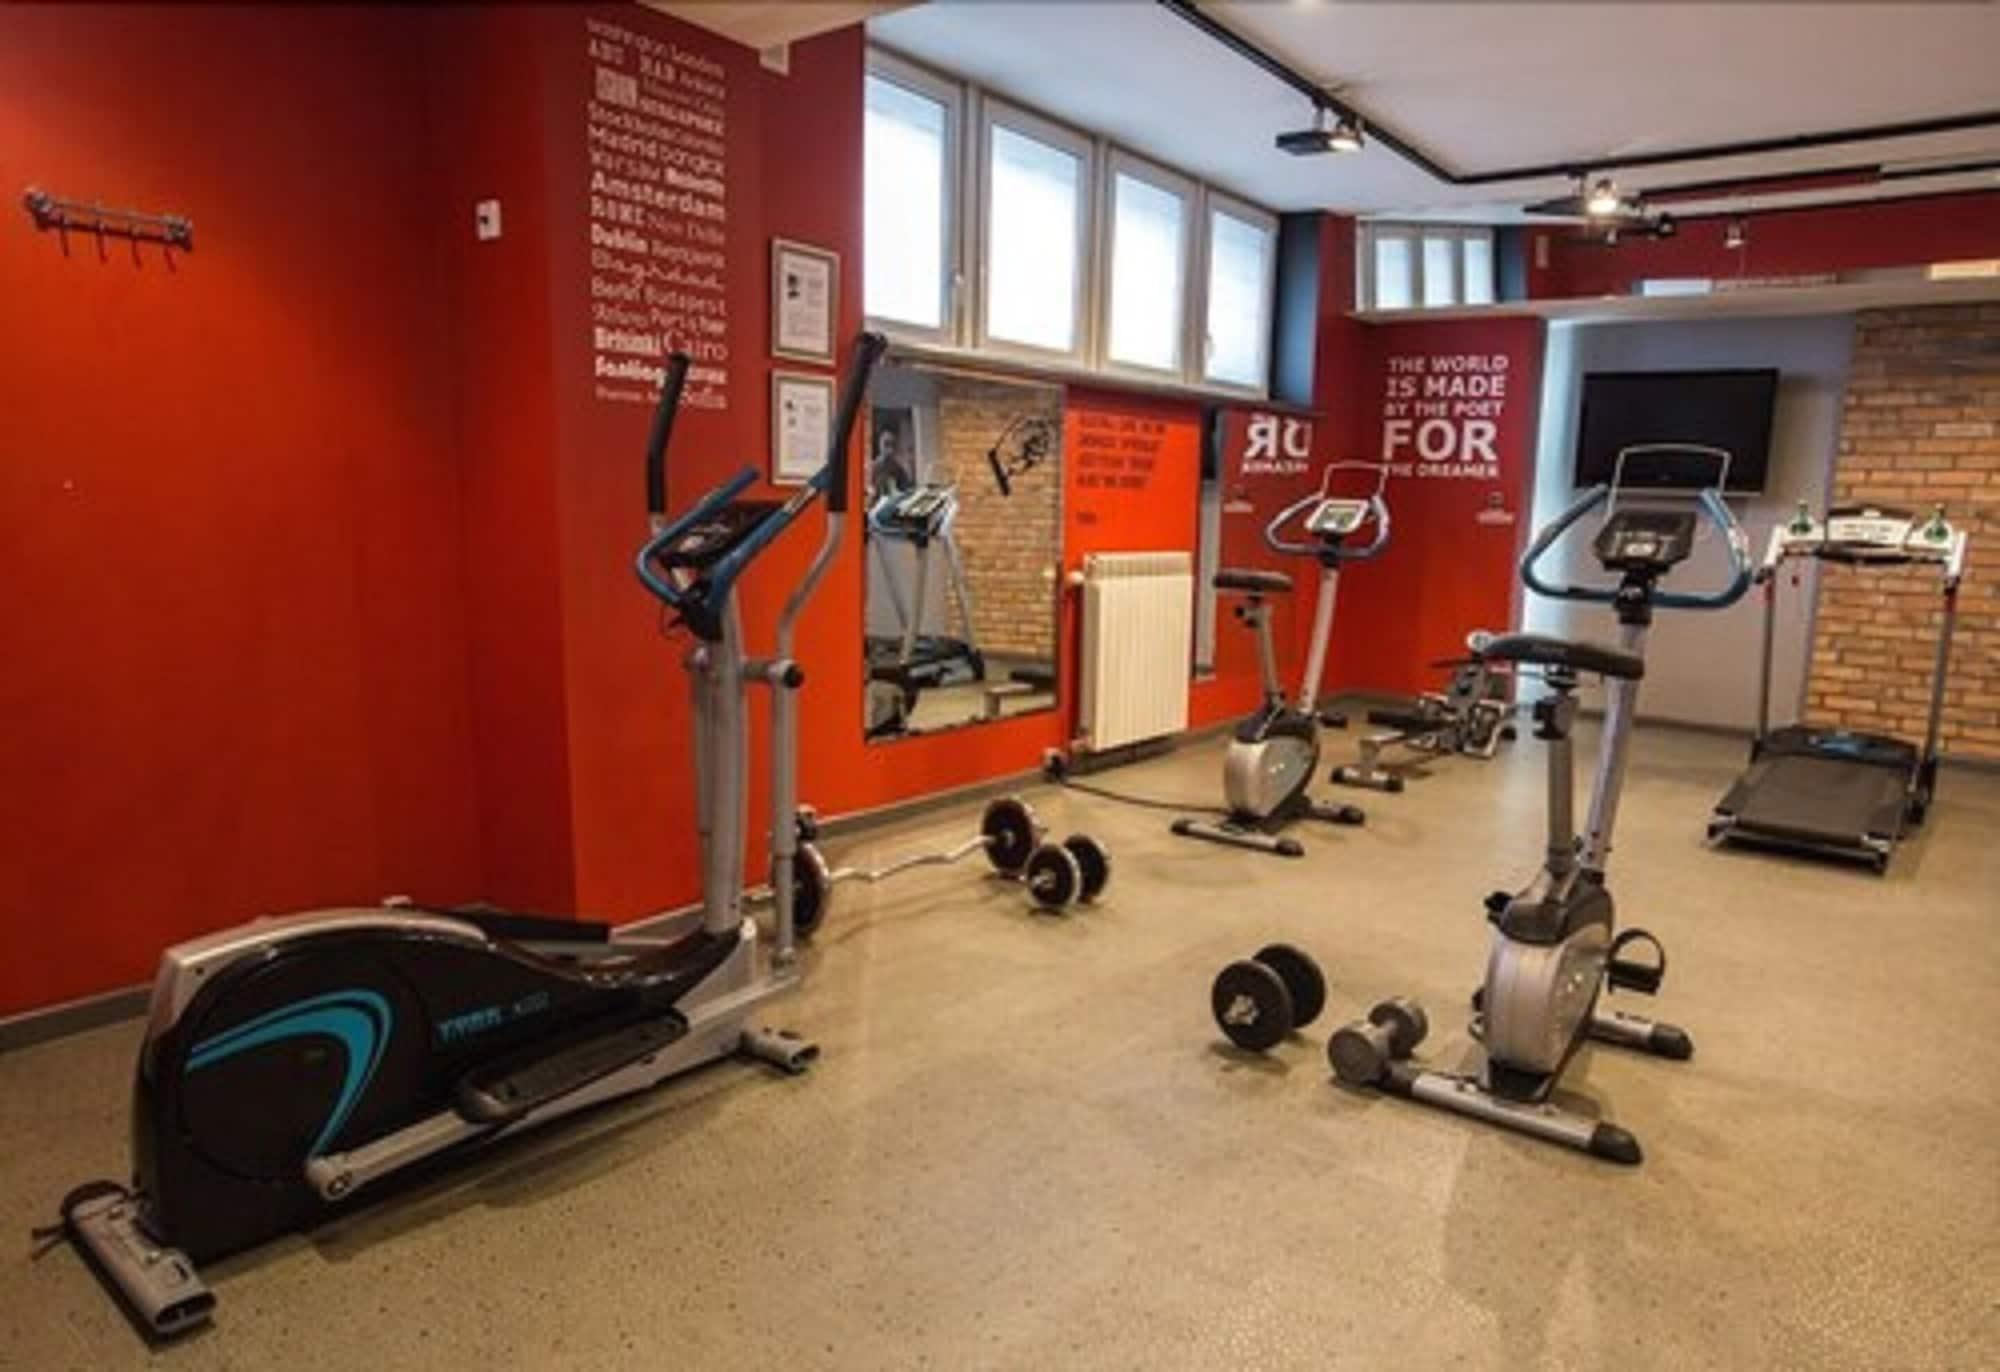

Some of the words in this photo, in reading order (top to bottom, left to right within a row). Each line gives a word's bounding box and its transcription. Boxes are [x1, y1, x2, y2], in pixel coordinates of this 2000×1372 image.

[591, 170, 725, 221] Amsterdam
[1389, 356, 1425, 373] THE
[1431, 354, 1509, 373] WORLD
[1386, 376, 1416, 397] IS
[1424, 375, 1506, 397] MADE
[1384, 402, 1408, 416] BY
[1414, 401, 1448, 416] THE
[1453, 401, 1504, 416] POET
[1383, 419, 1498, 461] FOR
[1417, 463, 1498, 477] DREAMER
